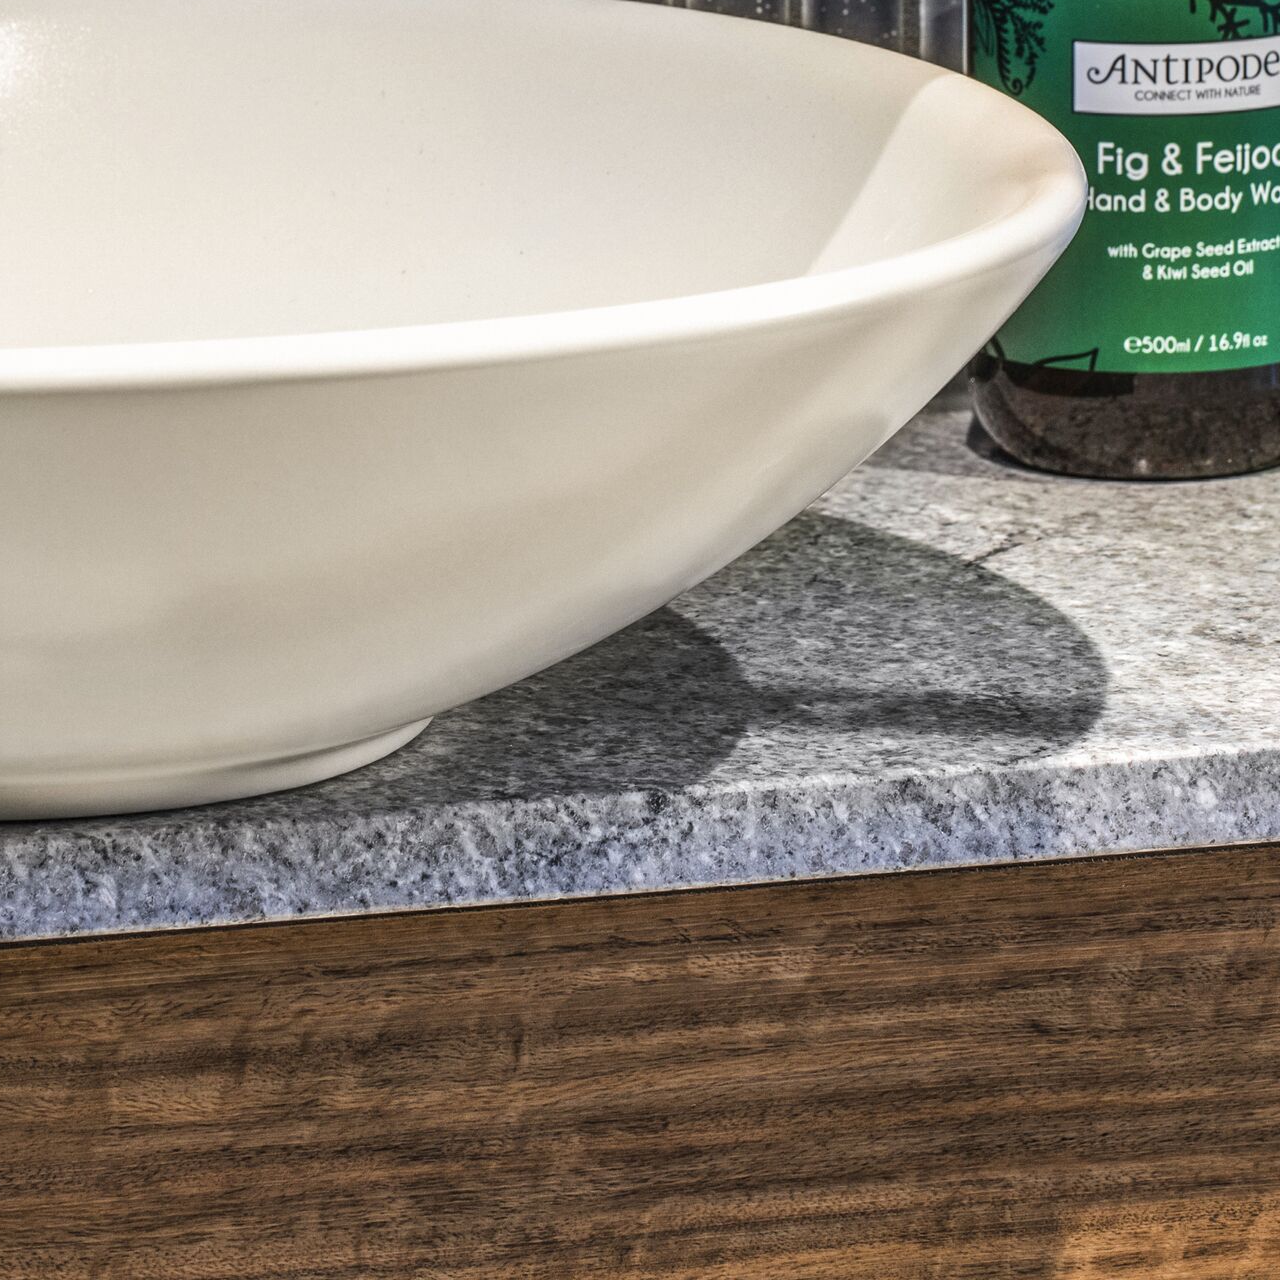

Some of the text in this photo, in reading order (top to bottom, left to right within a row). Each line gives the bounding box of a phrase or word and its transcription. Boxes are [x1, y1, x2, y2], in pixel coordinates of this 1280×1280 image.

[1134, 84, 1261, 102] CONNECT WITH NATURE
[1097, 141, 1148, 181] Fig
[1161, 142, 1183, 176] &
[1154, 187, 1170, 212] &
[1179, 185, 1243, 214] Body
[1107, 234, 1280, 262] with Grape Seed Extract
[1142, 260, 1254, 280] & Kiwi Seed Oil
[1194, 334, 1204, 352] /
[1252, 333, 1268, 347] oz
